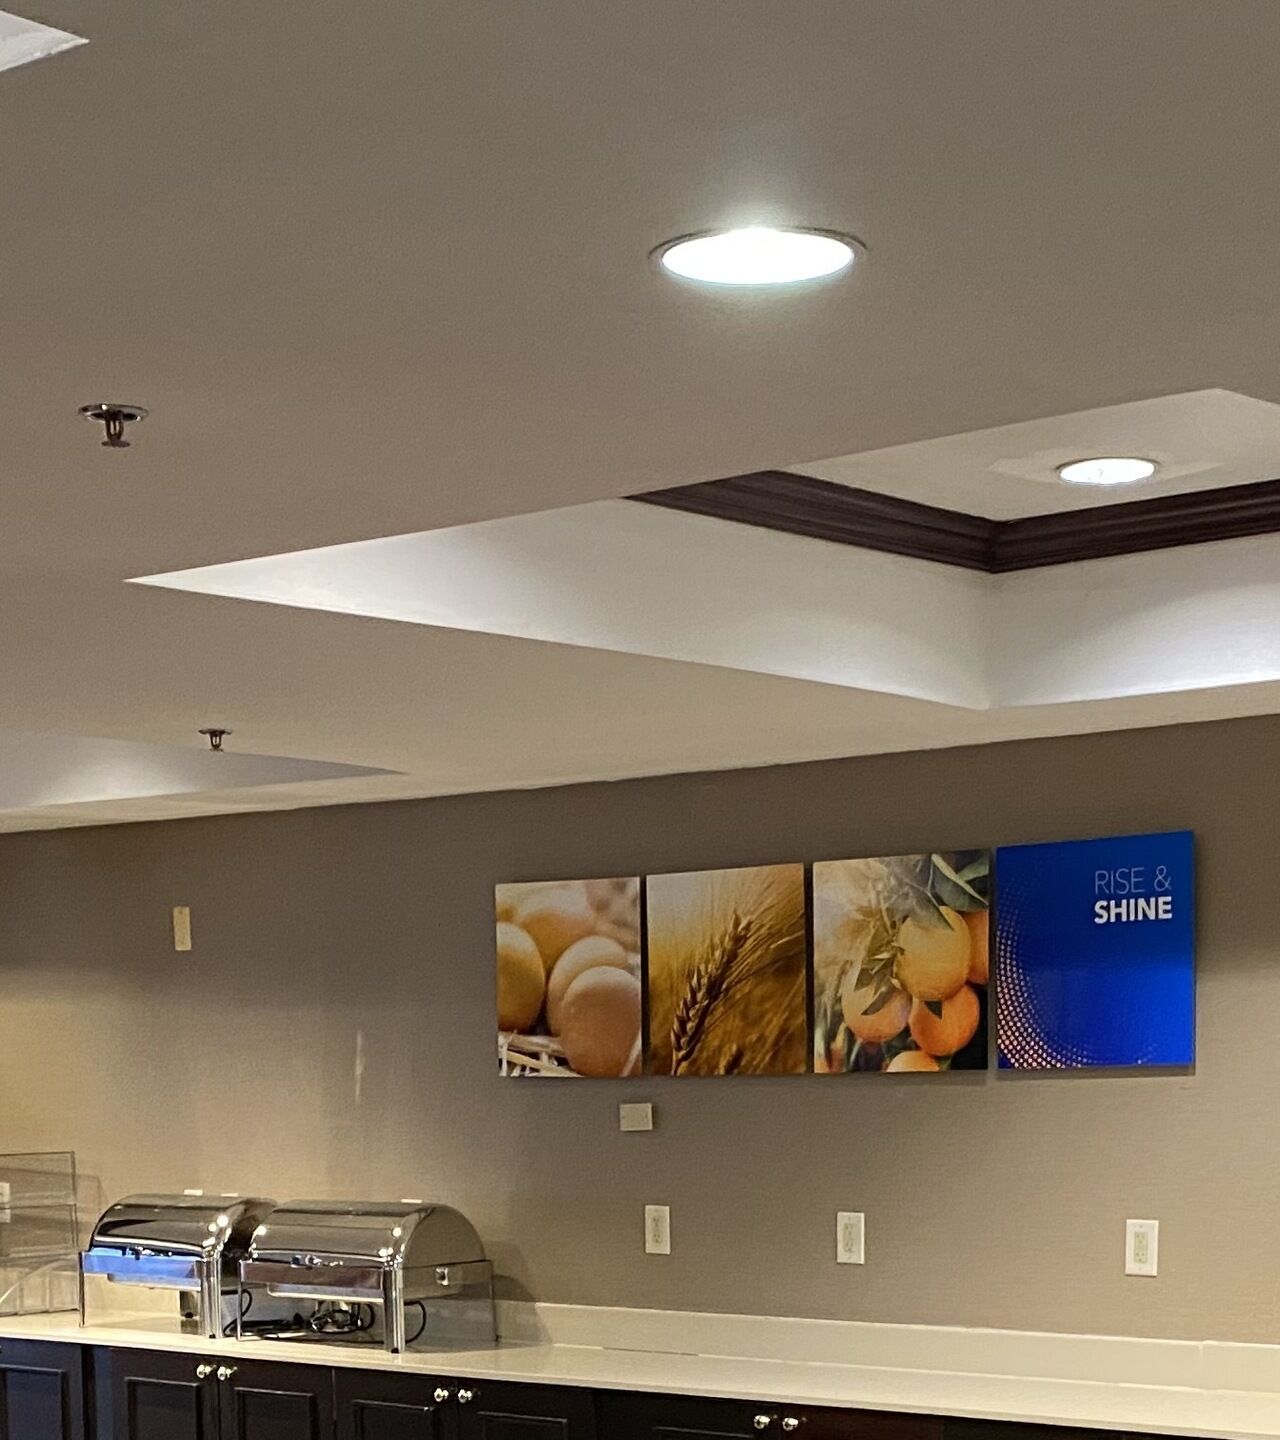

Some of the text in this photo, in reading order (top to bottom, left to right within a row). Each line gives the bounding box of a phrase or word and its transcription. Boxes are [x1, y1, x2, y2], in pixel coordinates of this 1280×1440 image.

[1095, 865, 1172, 895] RISE &
[1094, 896, 1173, 924] SHINE
